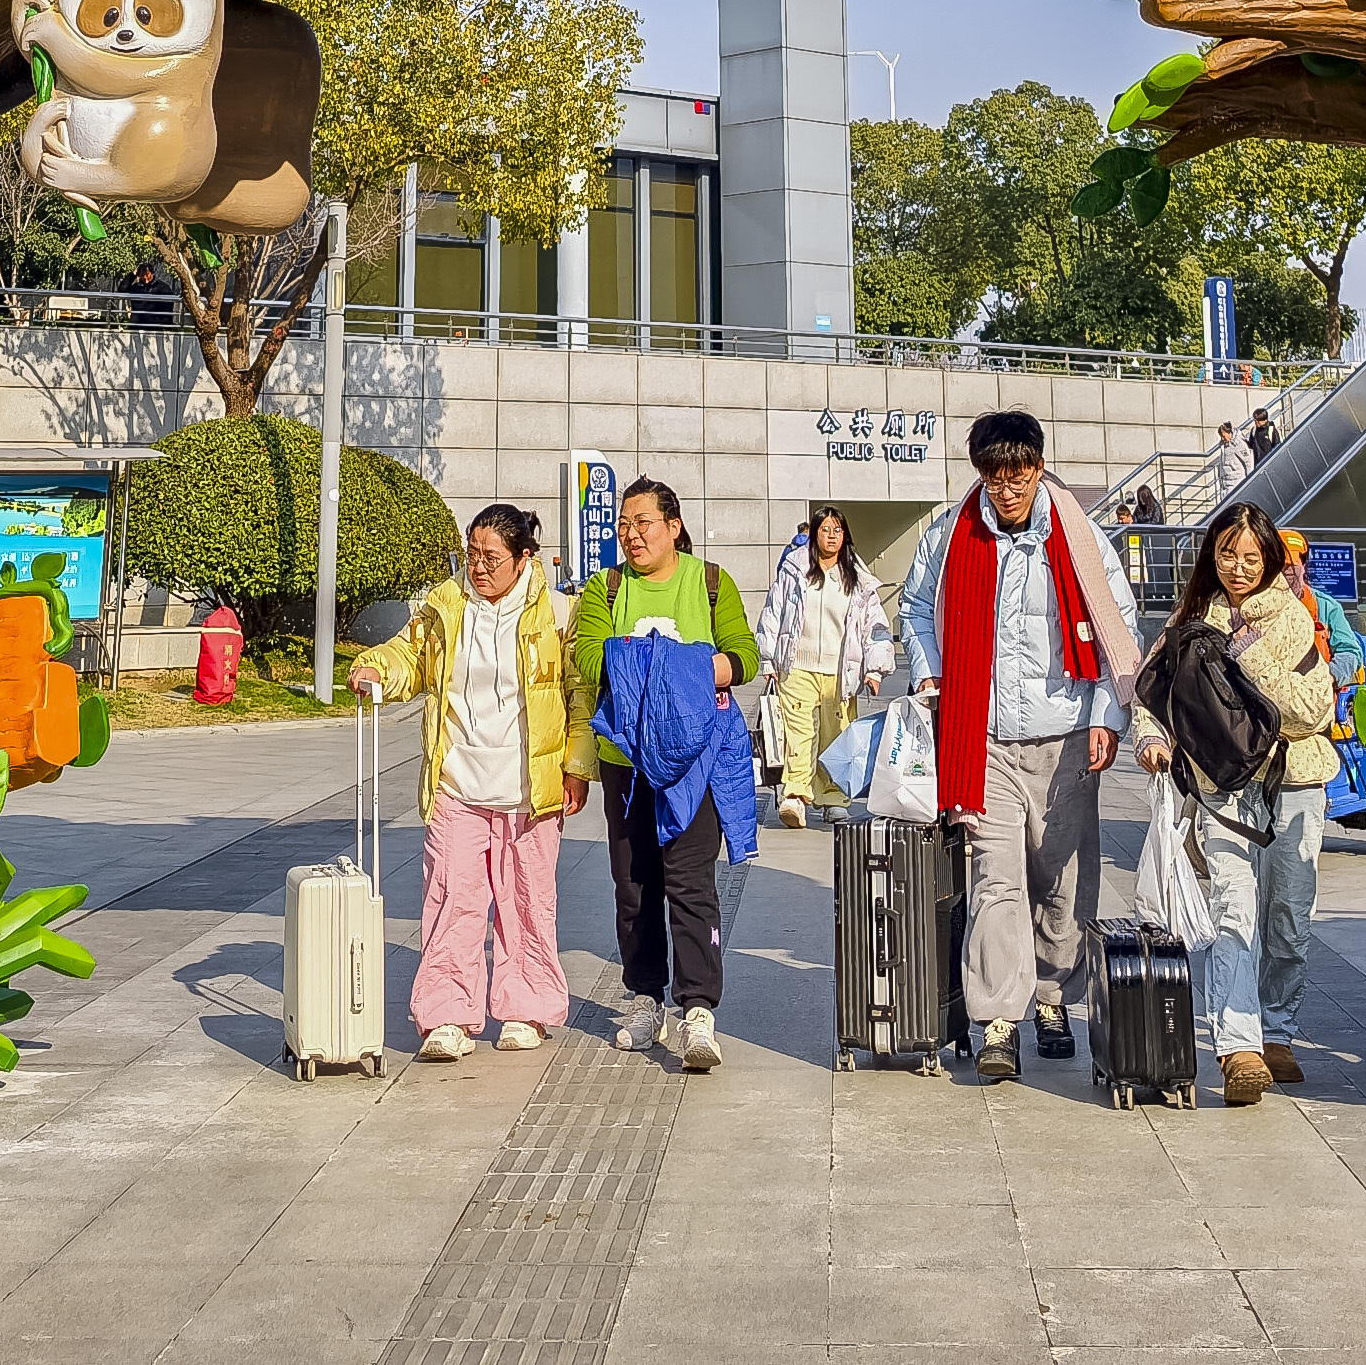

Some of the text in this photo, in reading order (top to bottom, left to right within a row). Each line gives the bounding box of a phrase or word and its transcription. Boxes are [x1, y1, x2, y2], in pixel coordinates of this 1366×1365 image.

[817, 408, 936, 440] 公共厕所
[828, 441, 928, 463] PUBLIC TOILET
[601, 491, 613, 523] 南门
